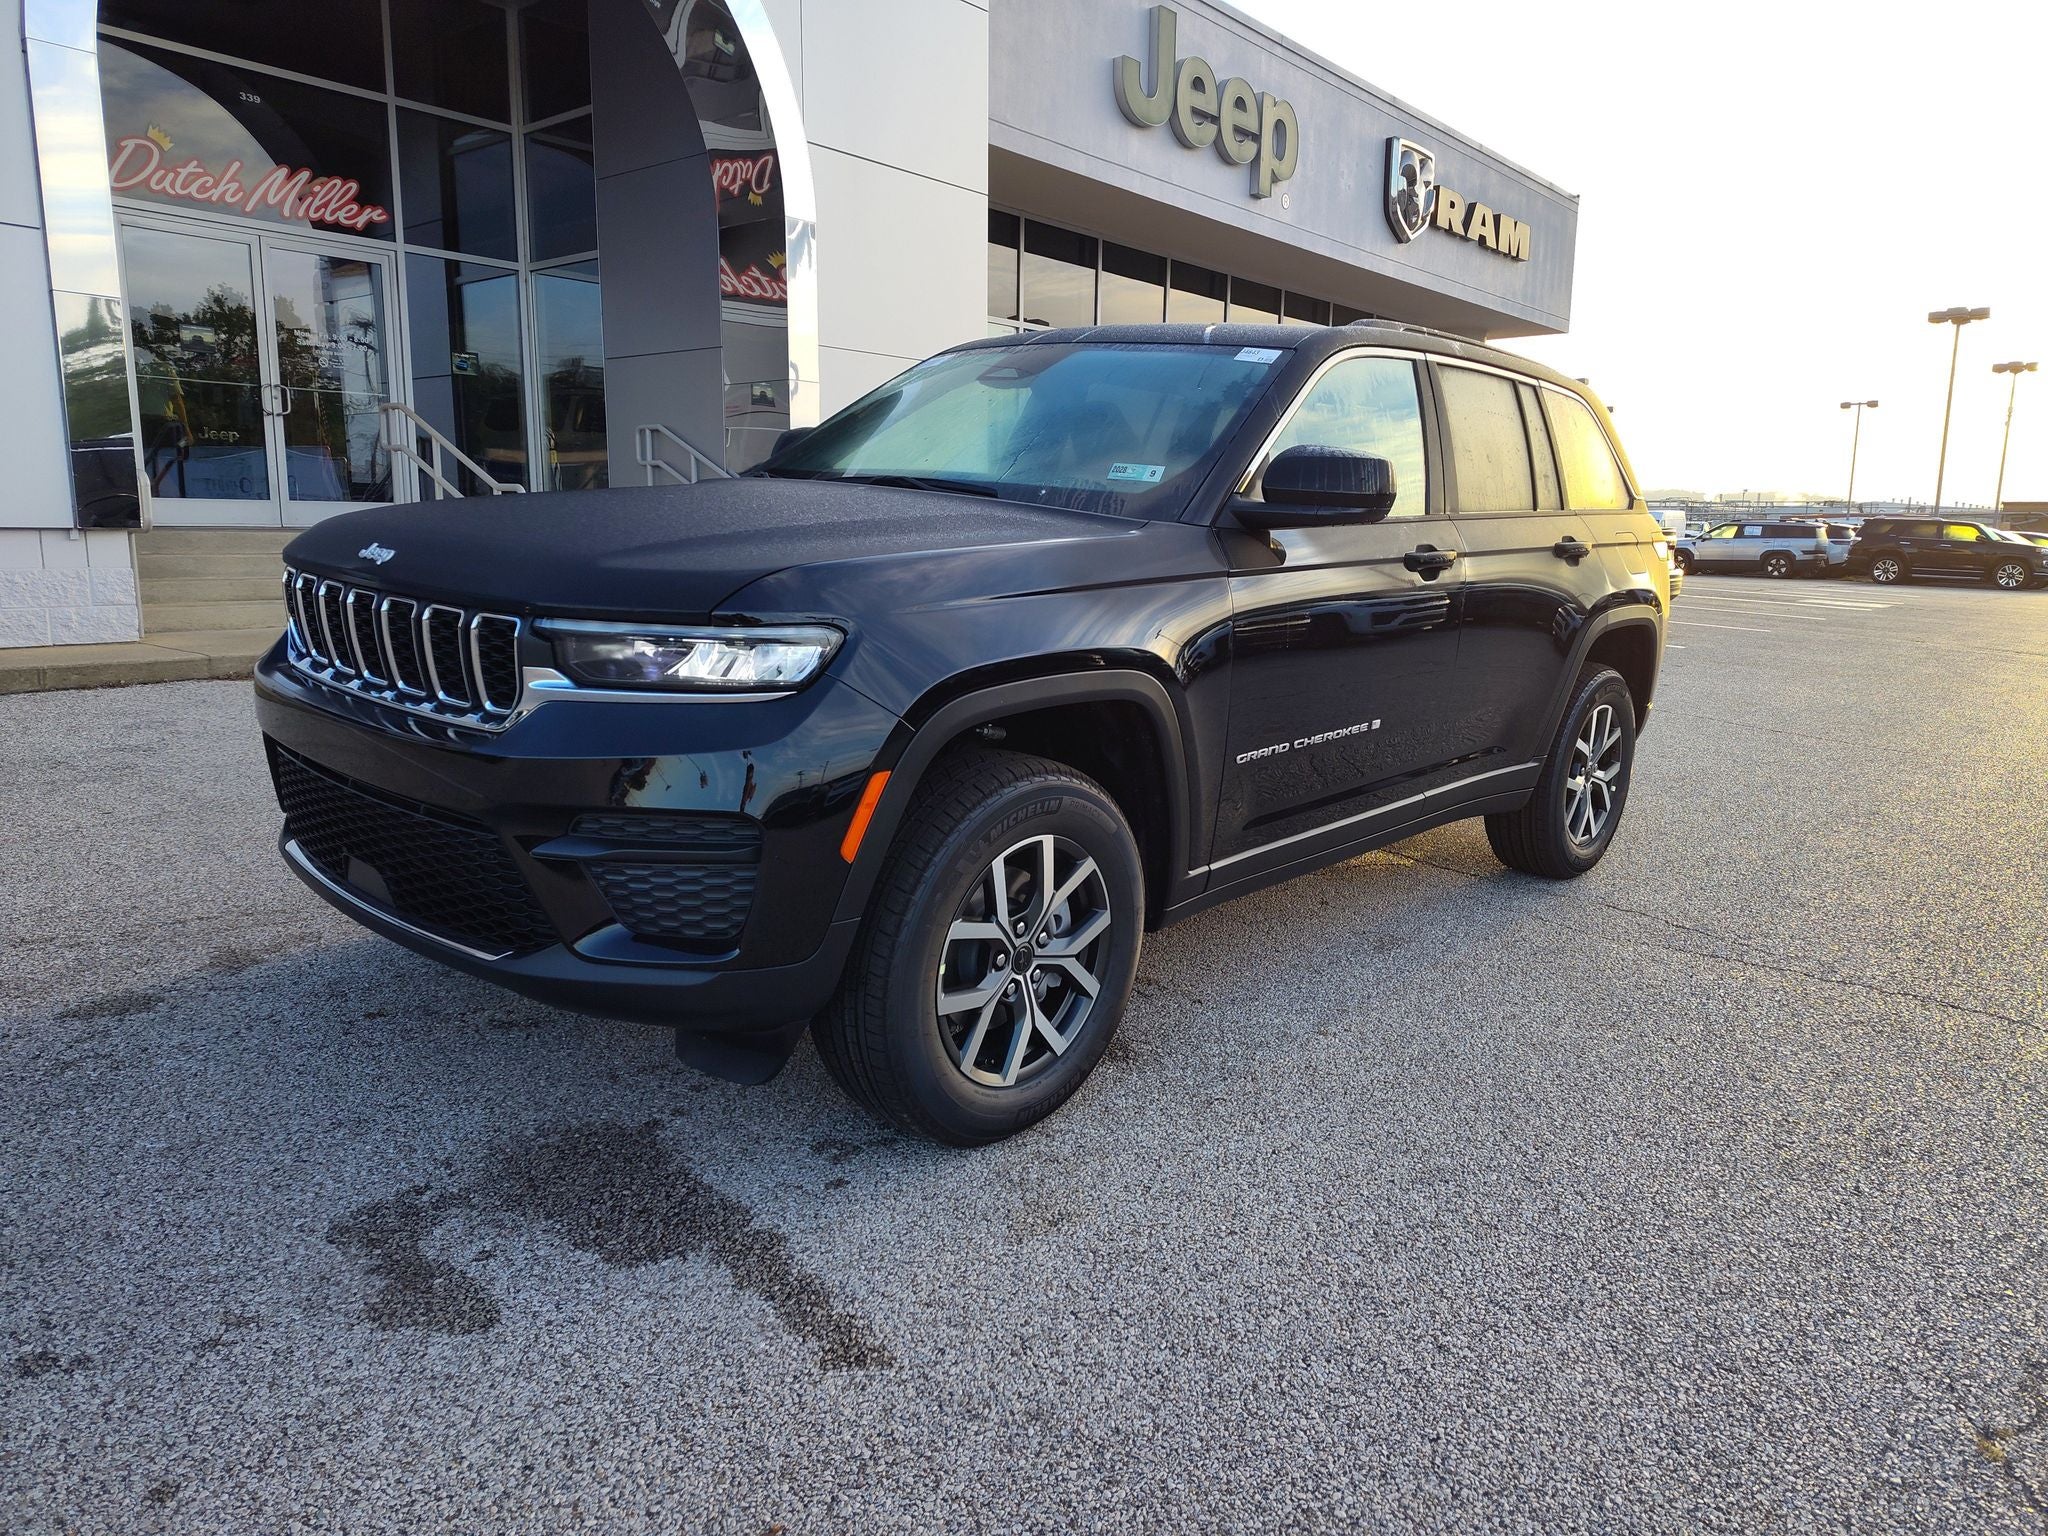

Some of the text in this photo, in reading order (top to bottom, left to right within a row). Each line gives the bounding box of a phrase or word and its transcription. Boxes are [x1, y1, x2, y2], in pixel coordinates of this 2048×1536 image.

[239, 91, 261, 104] 339
[1113, 5, 1299, 199] Jeep
[109, 137, 388, 230] Dutch Miller
[1434, 185, 1532, 261] RAM
[198, 426, 240, 443] Jeep
[1111, 465, 1157, 478] 2028 9
[358, 542, 396, 565] Jeep
[1236, 722, 1369, 765] GRAND CHEROKEE
[989, 799, 1061, 842] MICHELIN
